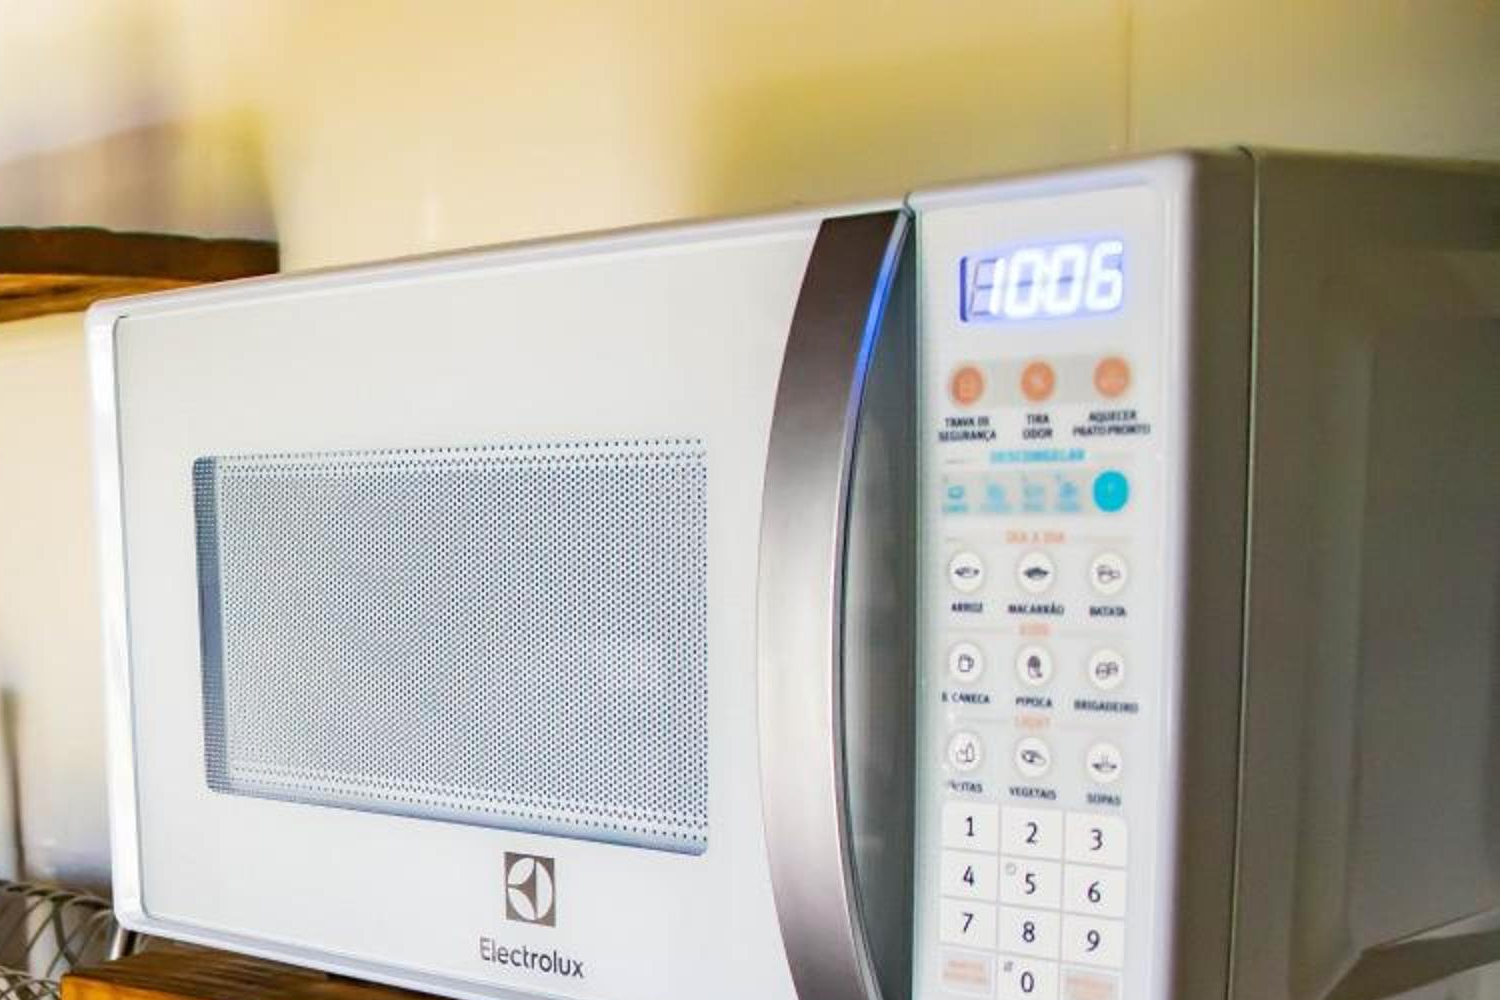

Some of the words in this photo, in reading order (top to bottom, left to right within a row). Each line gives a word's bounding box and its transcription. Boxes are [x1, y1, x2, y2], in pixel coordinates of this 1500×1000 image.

[1026, 413, 1050, 425] TIRA
[1088, 409, 1137, 422] AQUECER
[938, 430, 997, 443] SEGURANÇA
[1023, 429, 1053, 441] ODOR
[1007, 602, 1065, 616] MACARRÃO
[1015, 696, 1053, 709] PIPOCA
[1073, 699, 1139, 714] BRIGADEIRO
[1009, 785, 1057, 801] VEGETAIS
[1087, 792, 1123, 807] SOPAS
[965, 816, 975, 838] 1
[1025, 822, 1038, 844] 2
[1091, 829, 1104, 851] 3
[963, 866, 975, 887] 4
[1024, 873, 1037, 895] 5
[1087, 881, 1101, 904] 6
[961, 912, 974, 934] 7
[1022, 921, 1036, 943] 8
[1086, 930, 1100, 952] 9
[479, 936, 584, 979] Electrolux
[1021, 971, 1035, 994] 0
